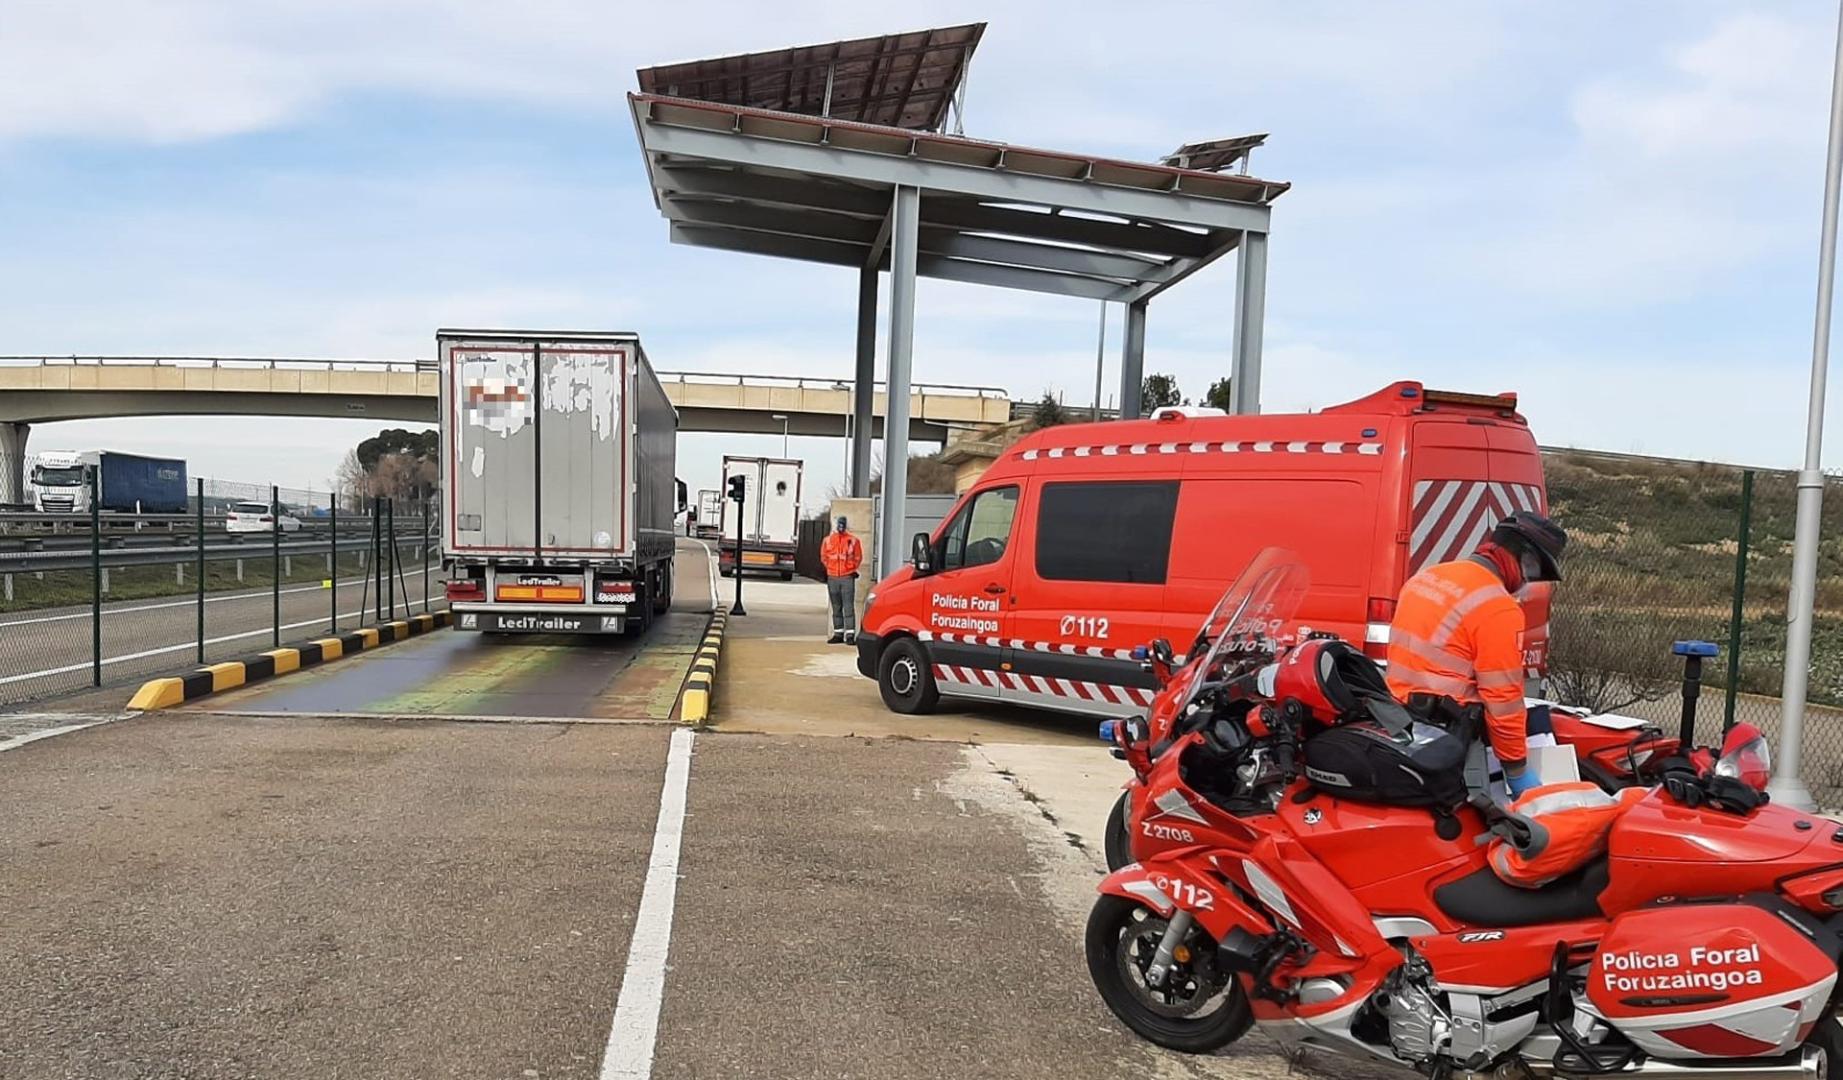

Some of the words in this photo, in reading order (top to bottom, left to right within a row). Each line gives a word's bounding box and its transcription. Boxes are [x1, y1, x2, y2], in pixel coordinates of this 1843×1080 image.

[970, 597, 999, 611] Foral
[498, 616, 581, 630] LeciTrailer
[931, 612, 998, 632] Foruzaingoa
[1076, 617, 1108, 638] 112
[1170, 878, 1214, 911] 112
[1461, 931, 1503, 943] FJR
[1690, 944, 1760, 967] Foral
[1604, 969, 1763, 992] Foruzaingoa
